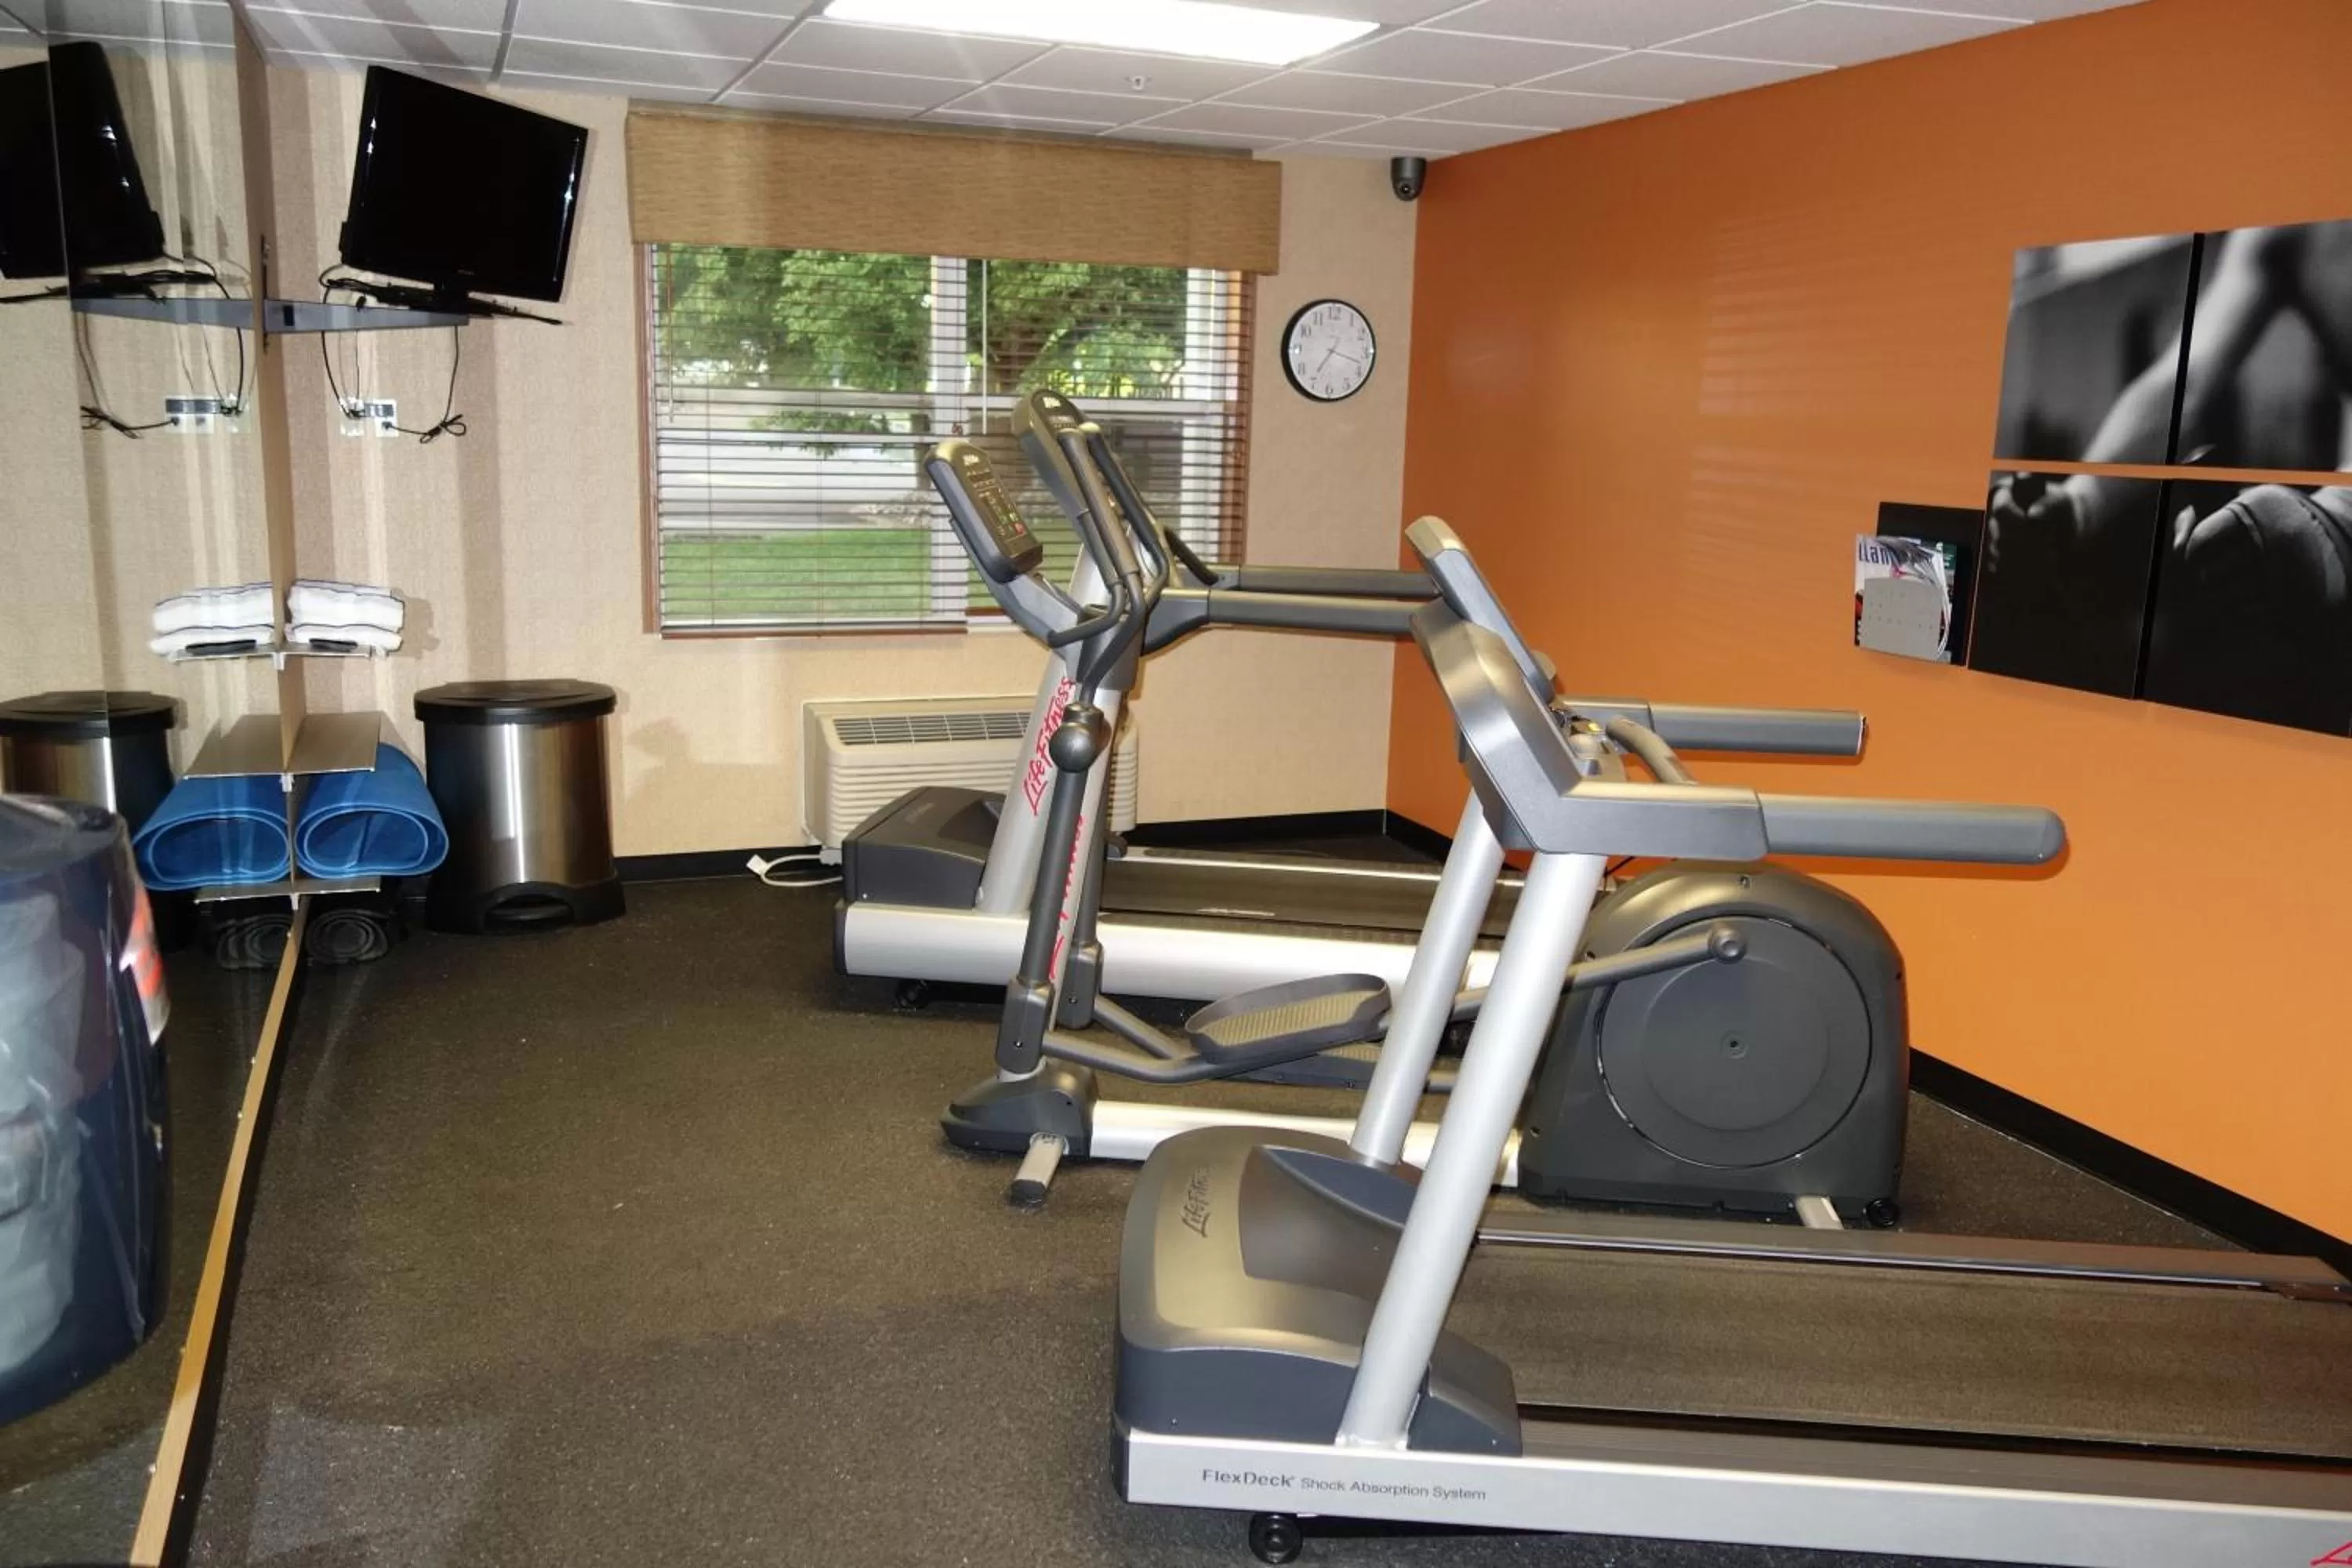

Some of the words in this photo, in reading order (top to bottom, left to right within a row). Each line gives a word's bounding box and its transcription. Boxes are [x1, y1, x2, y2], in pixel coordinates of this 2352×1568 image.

[1202, 1468, 1292, 1488] FlexDeck
[1300, 1476, 1346, 1492] Shock
[1350, 1480, 1430, 1498] Absorption
[1432, 1485, 1486, 1501] System
